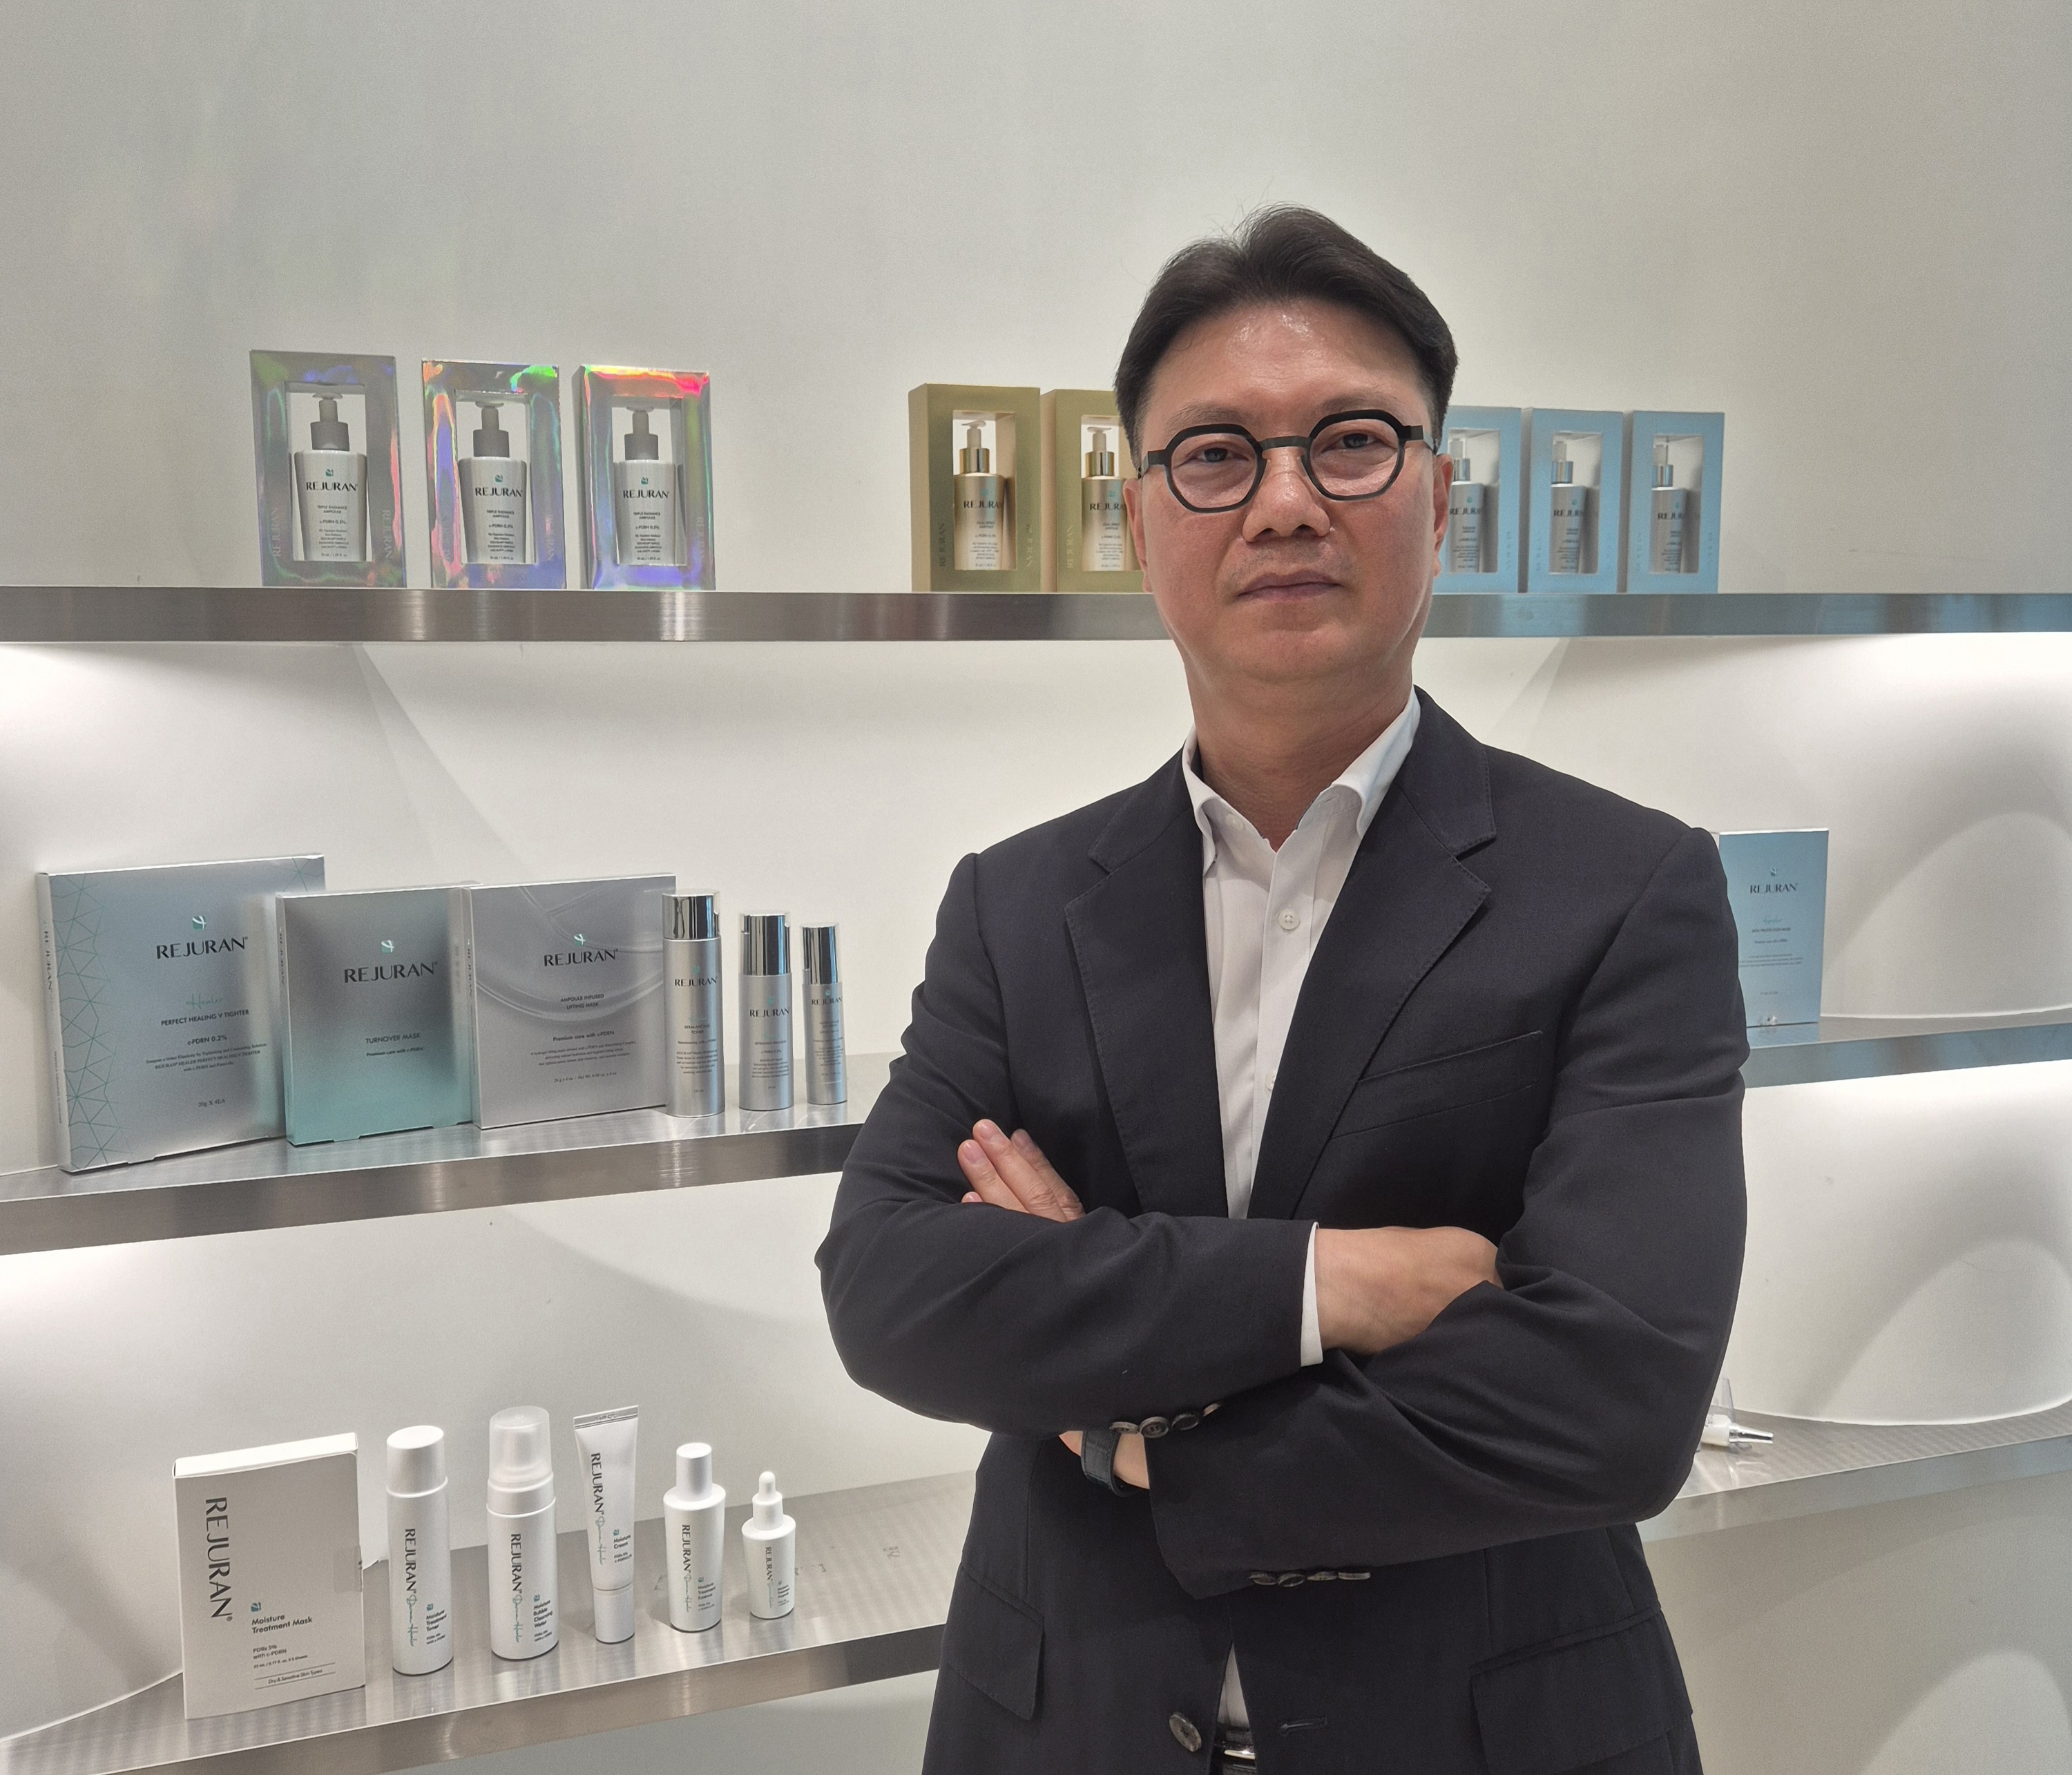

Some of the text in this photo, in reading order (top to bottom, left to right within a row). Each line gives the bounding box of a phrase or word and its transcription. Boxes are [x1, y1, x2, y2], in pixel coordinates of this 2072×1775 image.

[161, 1017, 187, 1026] PERFECT
[189, 1013, 217, 1022] HEALING
[224, 1009, 249, 1017] TIGHTER
[187, 1037, 210, 1045] c-PDRN
[365, 1035, 401, 1044] TURNOVER
[251, 1615, 285, 1625] Moisture
[251, 1616, 313, 1633] Treatment Mask
